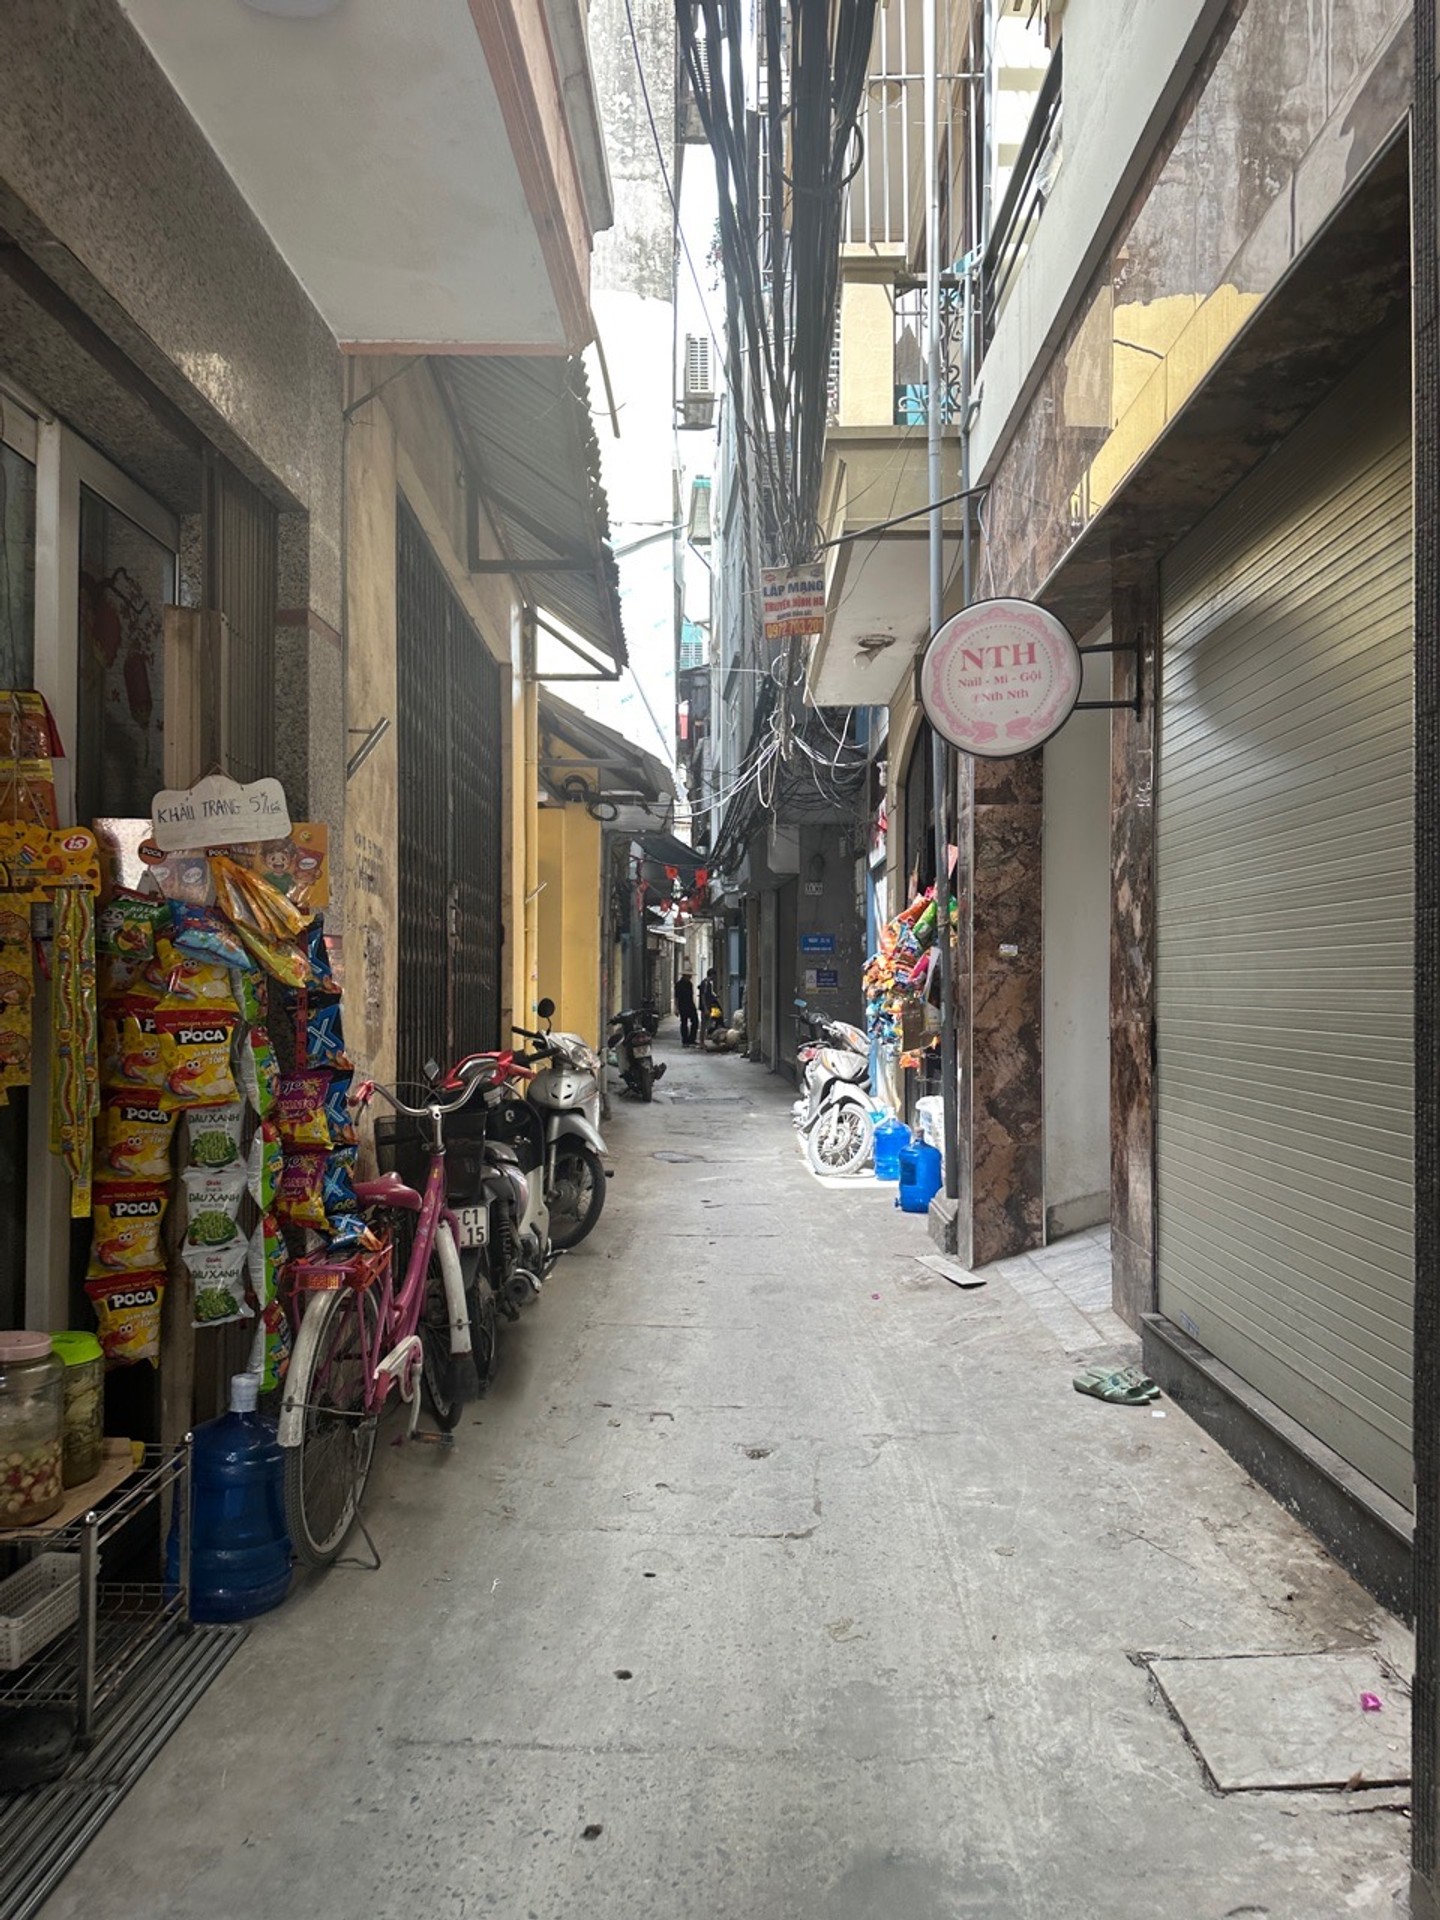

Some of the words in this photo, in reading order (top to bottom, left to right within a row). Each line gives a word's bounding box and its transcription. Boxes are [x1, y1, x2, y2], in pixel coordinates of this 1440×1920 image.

[960, 642, 1037, 672] NTH
[958, 677, 982, 689] Nail
[1020, 670, 1042, 683] Gội
[202, 799, 240, 818] TRANG
[178, 1029, 226, 1044] POCA
[125, 1106, 169, 1123] POCA
[114, 1201, 159, 1217] POCA
[111, 1289, 156, 1308] POCA
